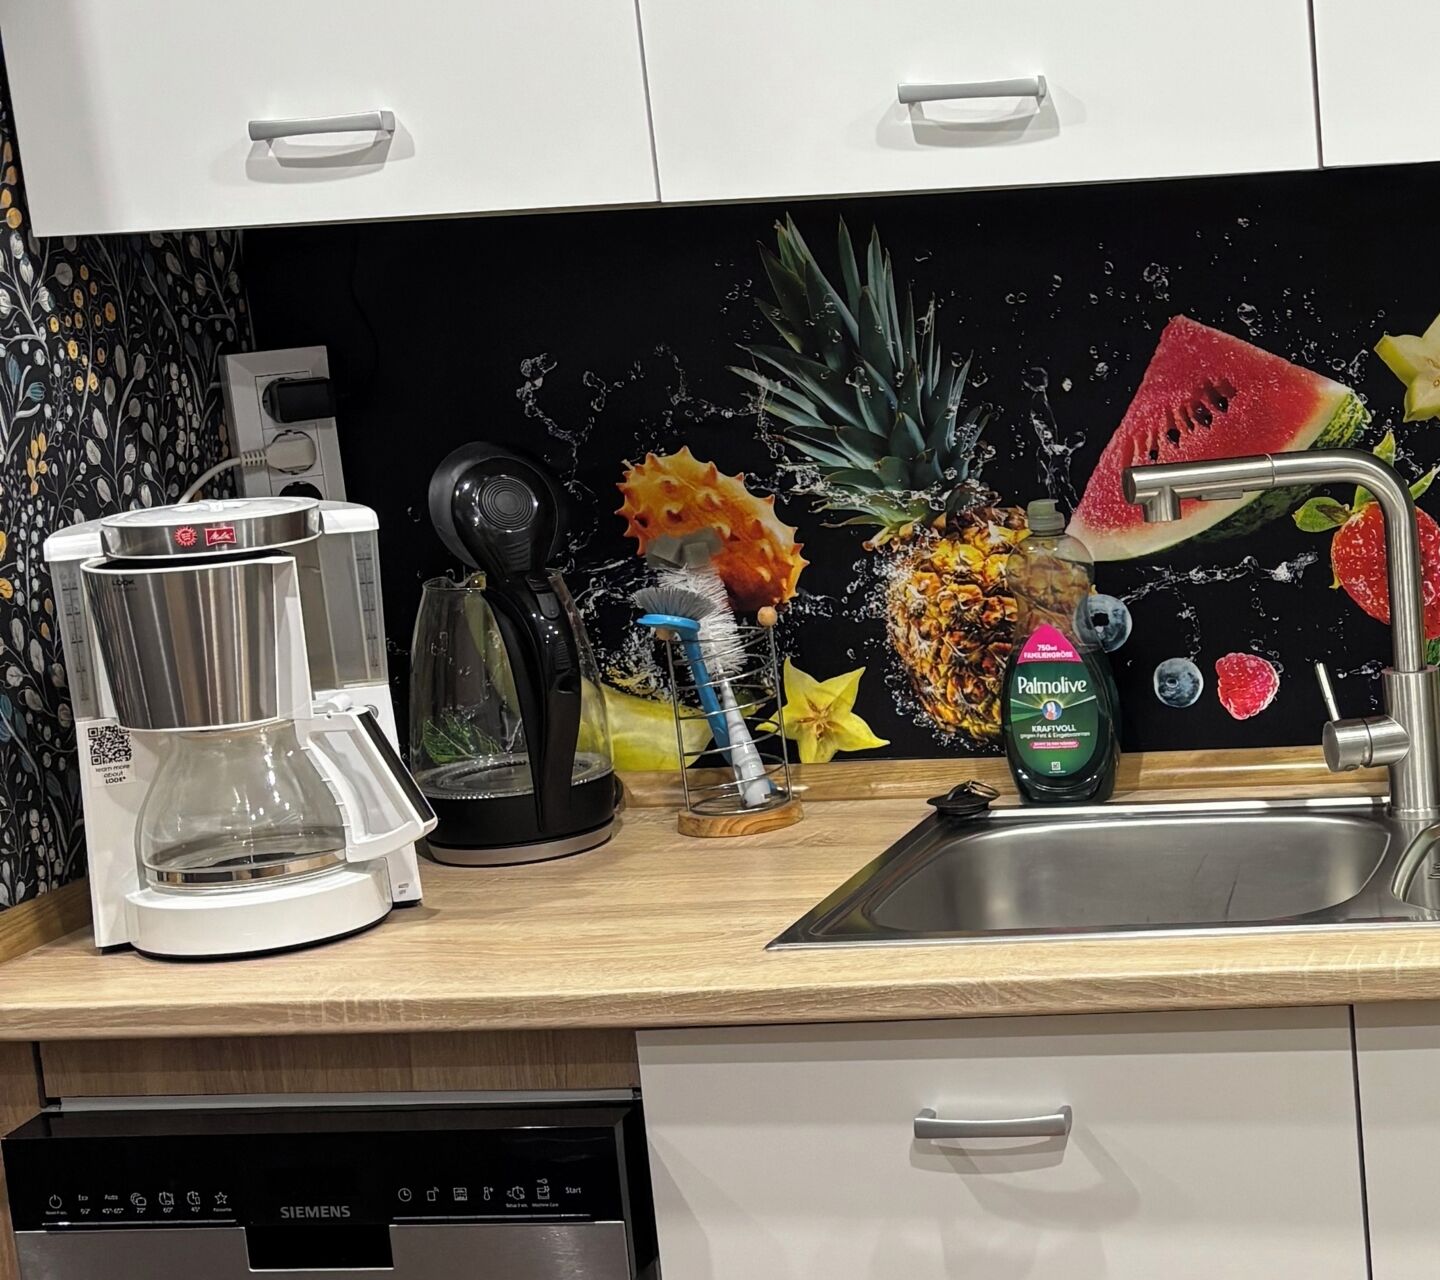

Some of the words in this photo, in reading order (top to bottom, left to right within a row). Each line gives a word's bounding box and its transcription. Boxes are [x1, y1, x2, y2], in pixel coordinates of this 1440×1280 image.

[1017, 676, 1087, 695] Palmolive
[1031, 724, 1077, 733] KRAFTVOLL
[280, 1205, 351, 1219] SIEMENS
